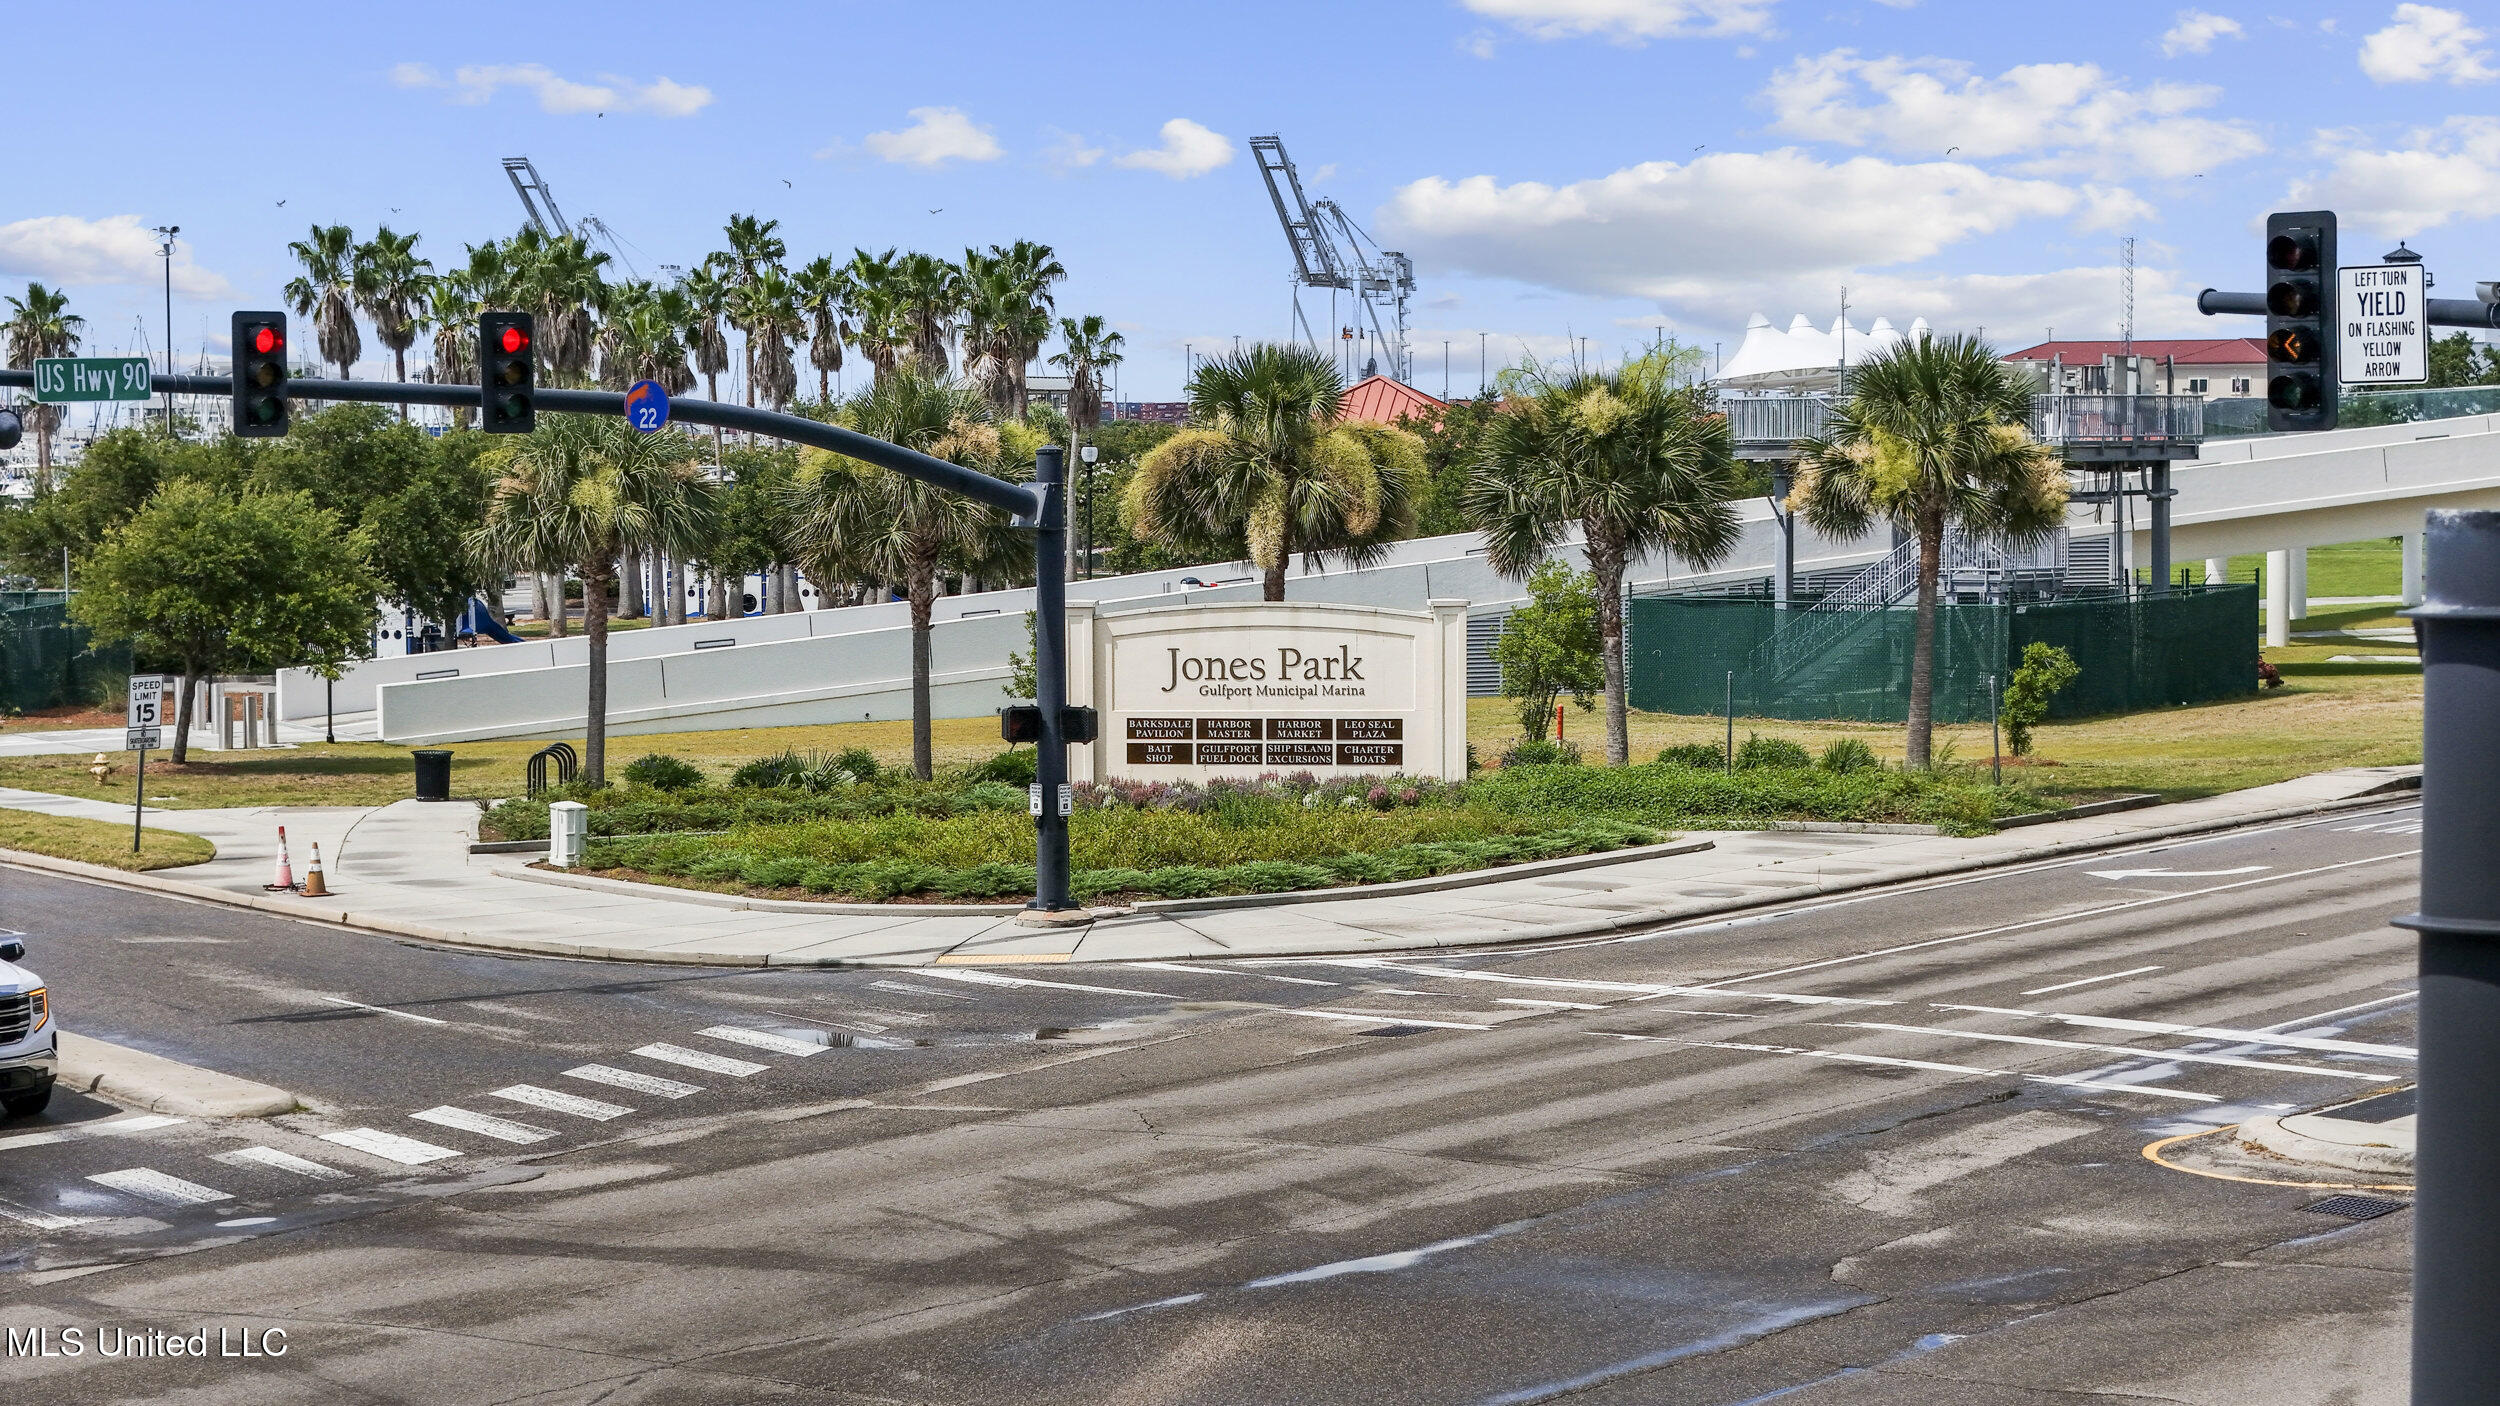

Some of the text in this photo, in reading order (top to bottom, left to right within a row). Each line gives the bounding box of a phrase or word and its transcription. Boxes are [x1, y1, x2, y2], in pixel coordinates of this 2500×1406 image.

[2355, 271, 2406, 286] LEFT TURN
[2357, 291, 2406, 316] YIELD
[2348, 321, 2415, 337] ON FLASHING
[2362, 342, 2401, 356] YELLOW
[2365, 362, 2400, 376] ARROW
[38, 362, 147, 400] US Hwy 90
[640, 408, 658, 428] 22
[1161, 644, 1365, 693] Jones Park
[132, 681, 160, 690] SPEED
[134, 692, 157, 700] LIMIT
[1199, 684, 1366, 700] Gulfport Municipal Marina
[136, 704, 155, 722] 15
[1129, 720, 1192, 728] BARKSDALE
[1208, 720, 1252, 729] HARBOR
[1278, 720, 1322, 729] HARBOR
[1344, 720, 1395, 729] LEO SEAL
[1136, 730, 1184, 738] PAVILION
[1208, 730, 1251, 738] MASTER
[1278, 730, 1322, 738] MARKET
[1148, 745, 1172, 753] BAIT
[1202, 745, 1258, 753] GULFPORT
[1268, 745, 1332, 753] SHIP ISLAND
[1344, 746, 1394, 754] CHARTER
[1146, 754, 1174, 763] SHOP
[1200, 755, 1260, 763] FUEL DOCK
[1268, 755, 1332, 764] EXCURSIONS
[1353, 756, 1386, 764] BOATS
